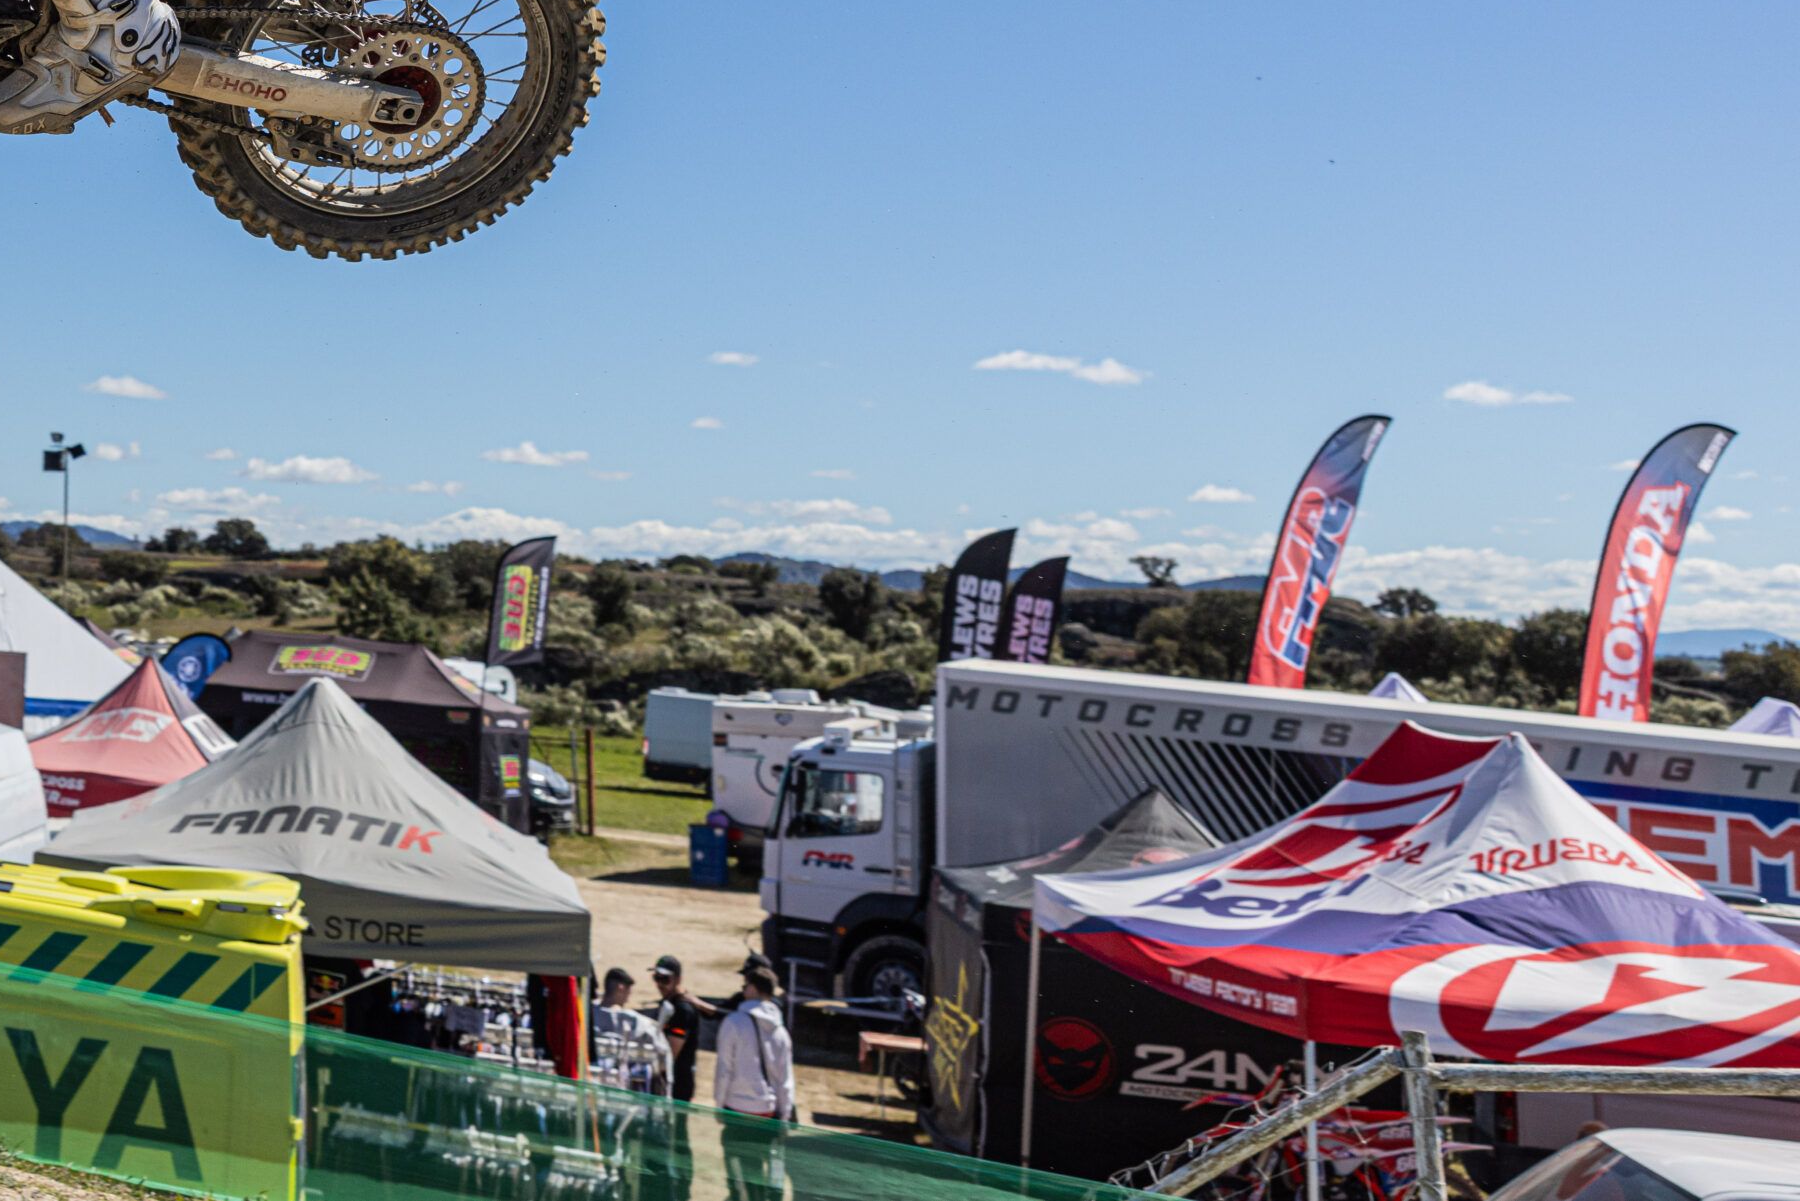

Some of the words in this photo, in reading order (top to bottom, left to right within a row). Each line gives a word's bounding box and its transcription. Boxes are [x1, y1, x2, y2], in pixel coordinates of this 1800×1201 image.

[207, 72, 287, 103] CHOHO
[11, 118, 46, 135] FOX
[1595, 481, 1691, 722] HONDA
[1008, 594, 1034, 662] EWS
[946, 684, 1353, 748] MOTOCROSS
[167, 803, 443, 855] FANATIK
[1469, 837, 1653, 876] TRUEBA
[324, 915, 426, 947] STORE
